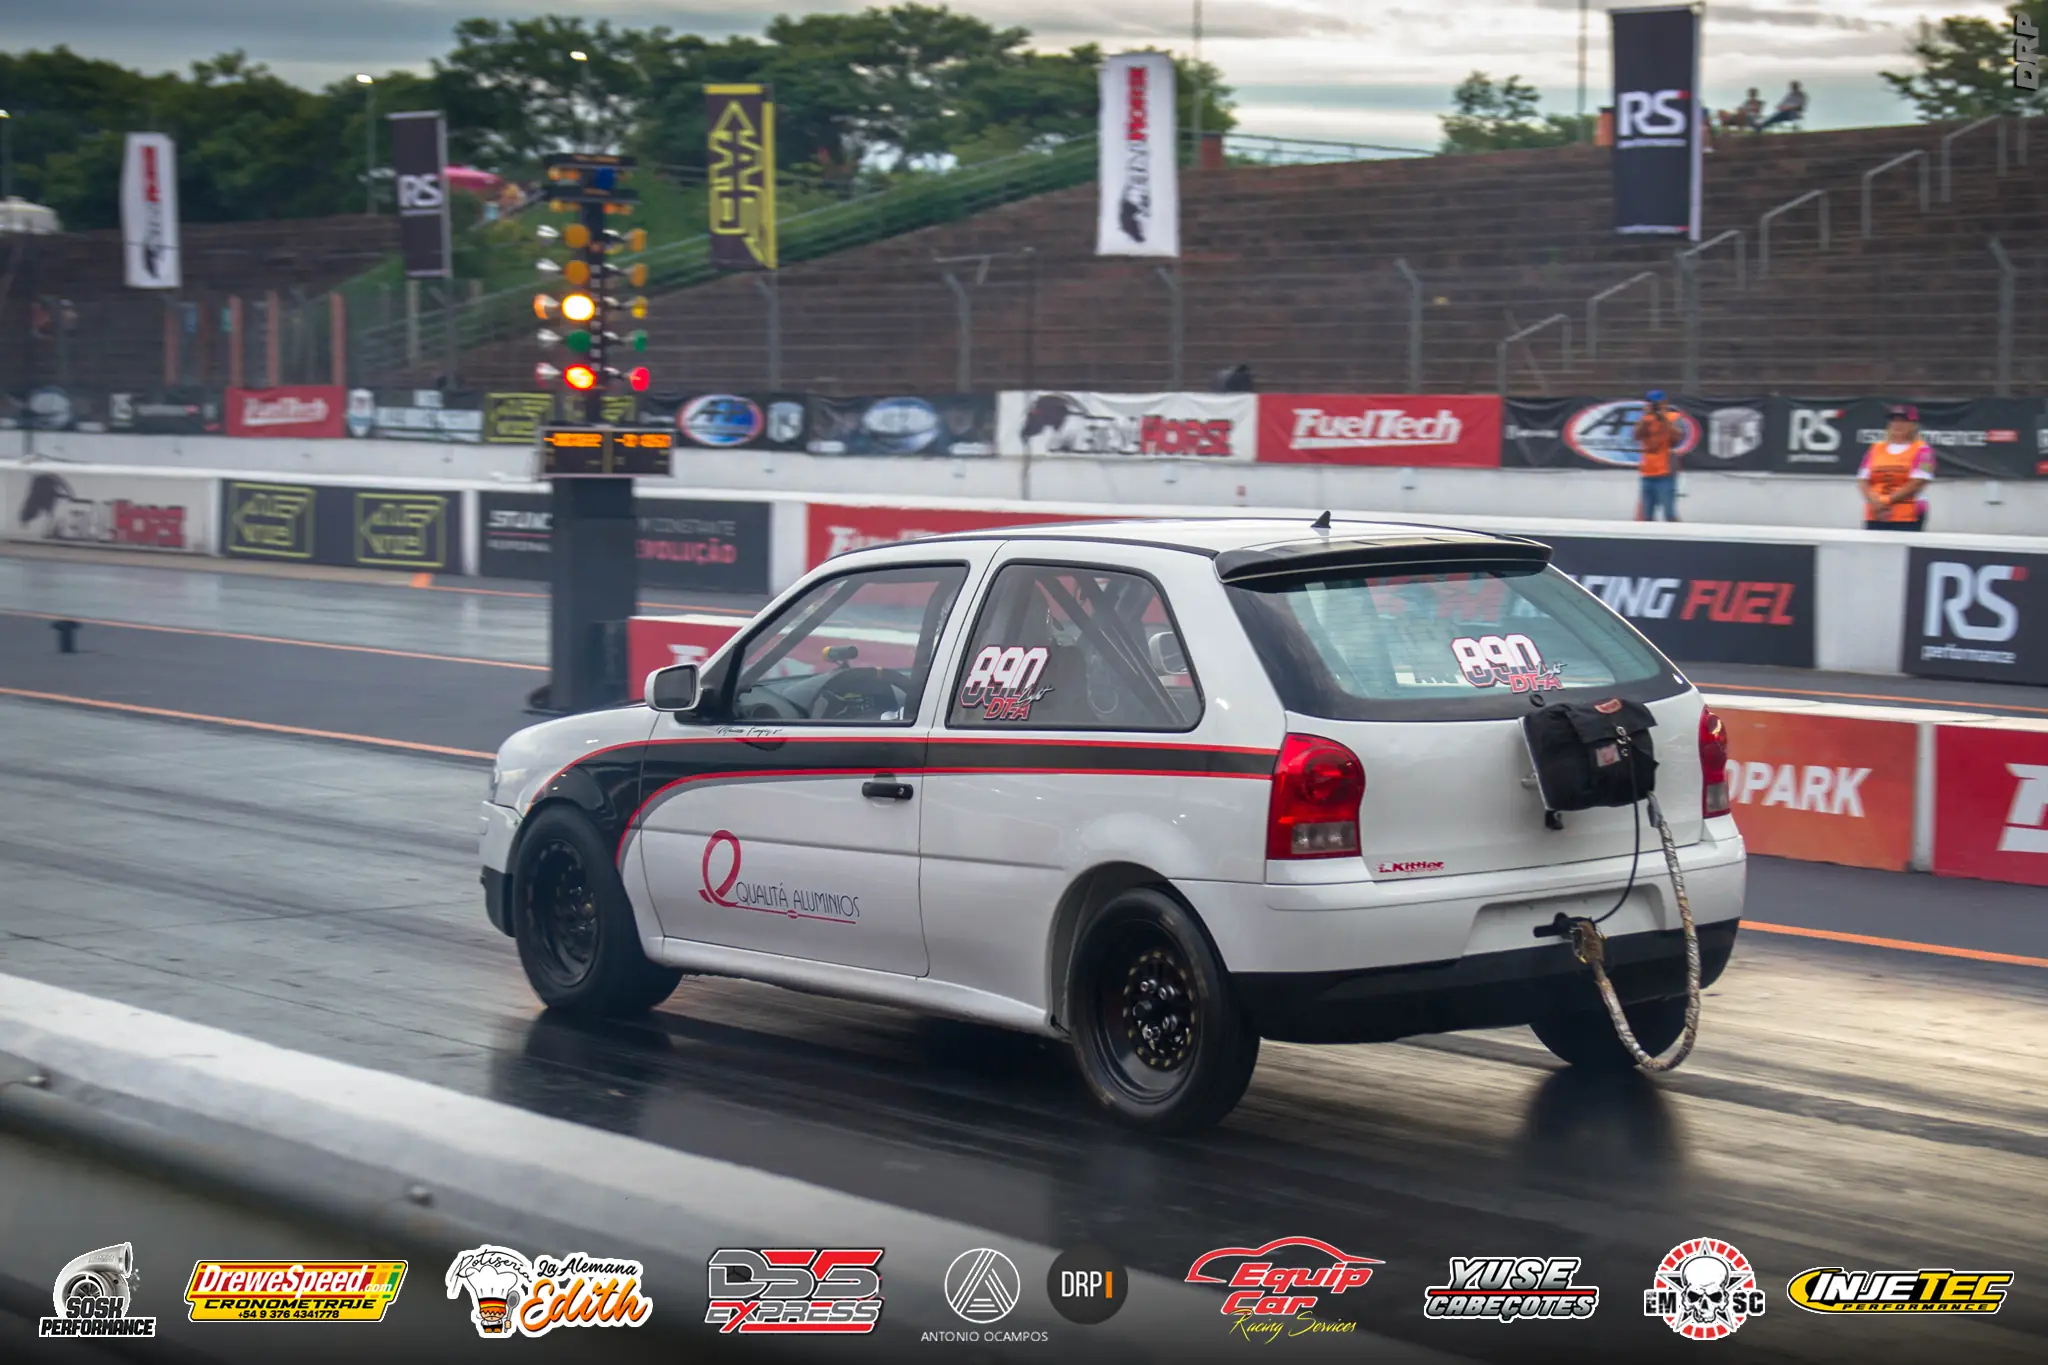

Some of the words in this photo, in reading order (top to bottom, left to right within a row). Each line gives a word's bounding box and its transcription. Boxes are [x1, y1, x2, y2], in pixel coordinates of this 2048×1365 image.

[1617, 90, 1689, 136] RS
[398, 175, 444, 207] RS
[1289, 408, 1462, 449] FuelTech
[1789, 409, 1845, 451] RS
[1680, 580, 1795, 625] FUEL
[1923, 561, 2029, 641] RS
[961, 645, 1049, 707] 890
[1451, 633, 1547, 688] 890
[736, 881, 788, 909] QUALITÁ
[793, 889, 860, 918] ALUMINIOS
